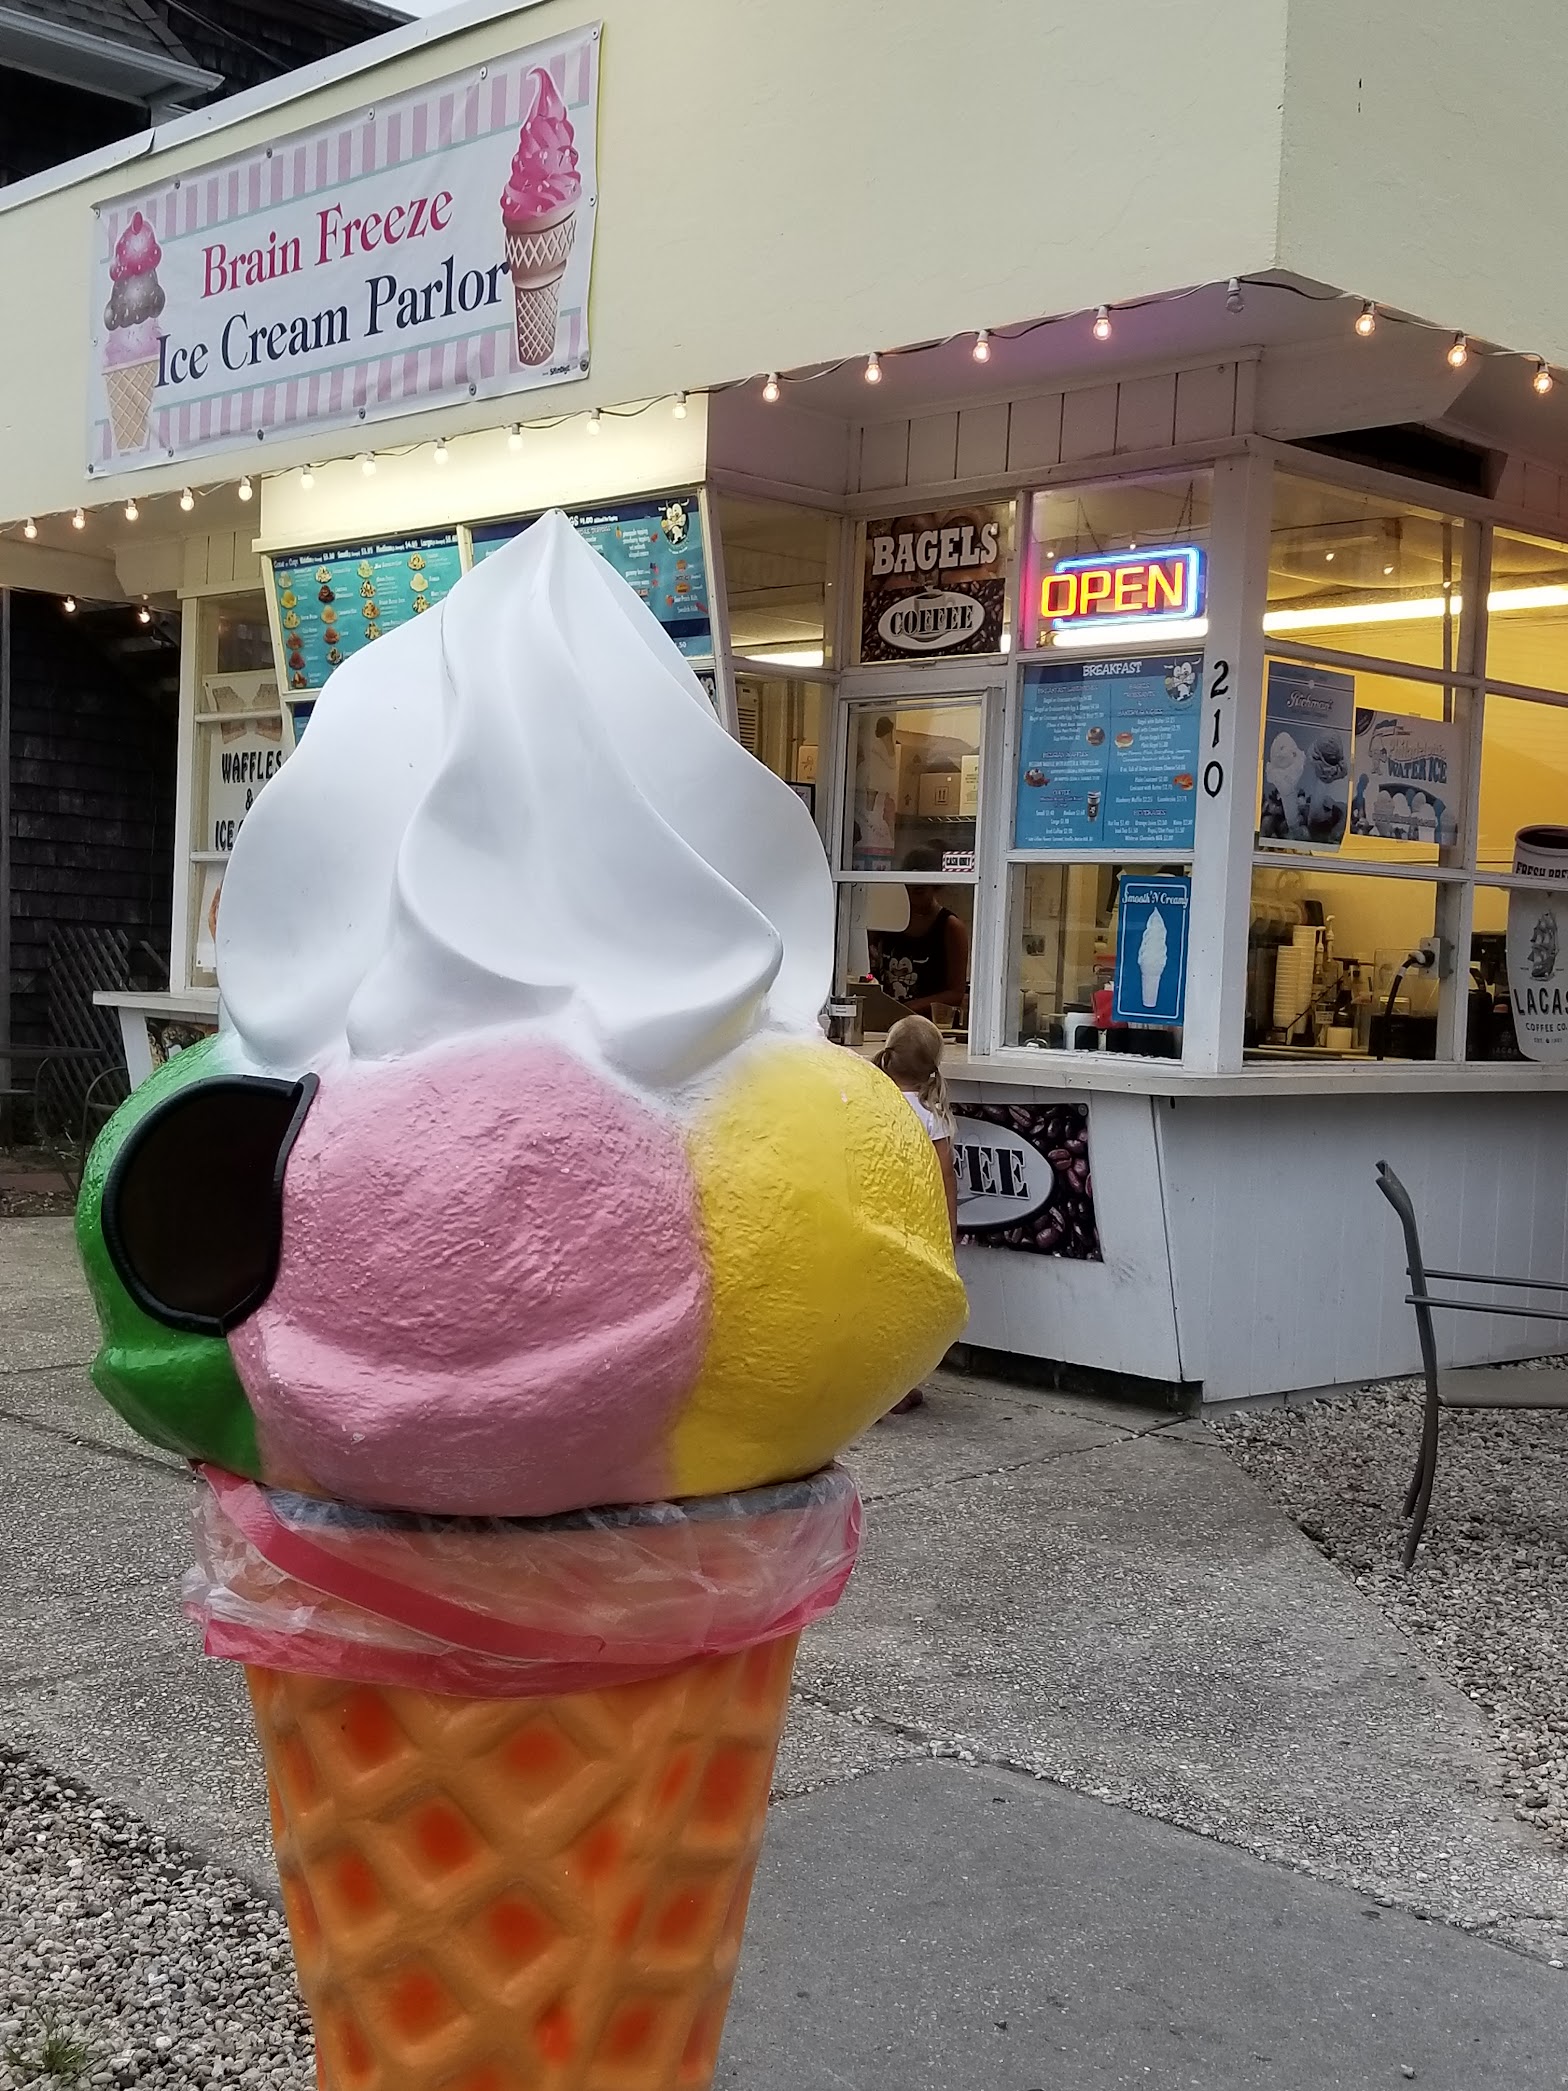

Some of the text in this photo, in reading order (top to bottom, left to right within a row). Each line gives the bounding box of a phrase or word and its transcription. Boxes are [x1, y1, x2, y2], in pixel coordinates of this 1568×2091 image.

[201, 189, 455, 299] Brain Freeze
[154, 256, 511, 389] Ice Cream Parlor
[872, 523, 998, 575] BAGELS
[1041, 562, 1184, 618] OPEN
[890, 605, 973, 636] COFFEE
[1082, 661, 1142, 677] BREAKFAST
[1203, 659, 1230, 798] 210
[221, 750, 283, 784] WAFFLES
[1388, 757, 1448, 785] WATER ICE
[245, 788, 254, 811] &
[215, 819, 234, 851] ICE
[1525, 1022, 1568, 1032] COFFEE CO.
